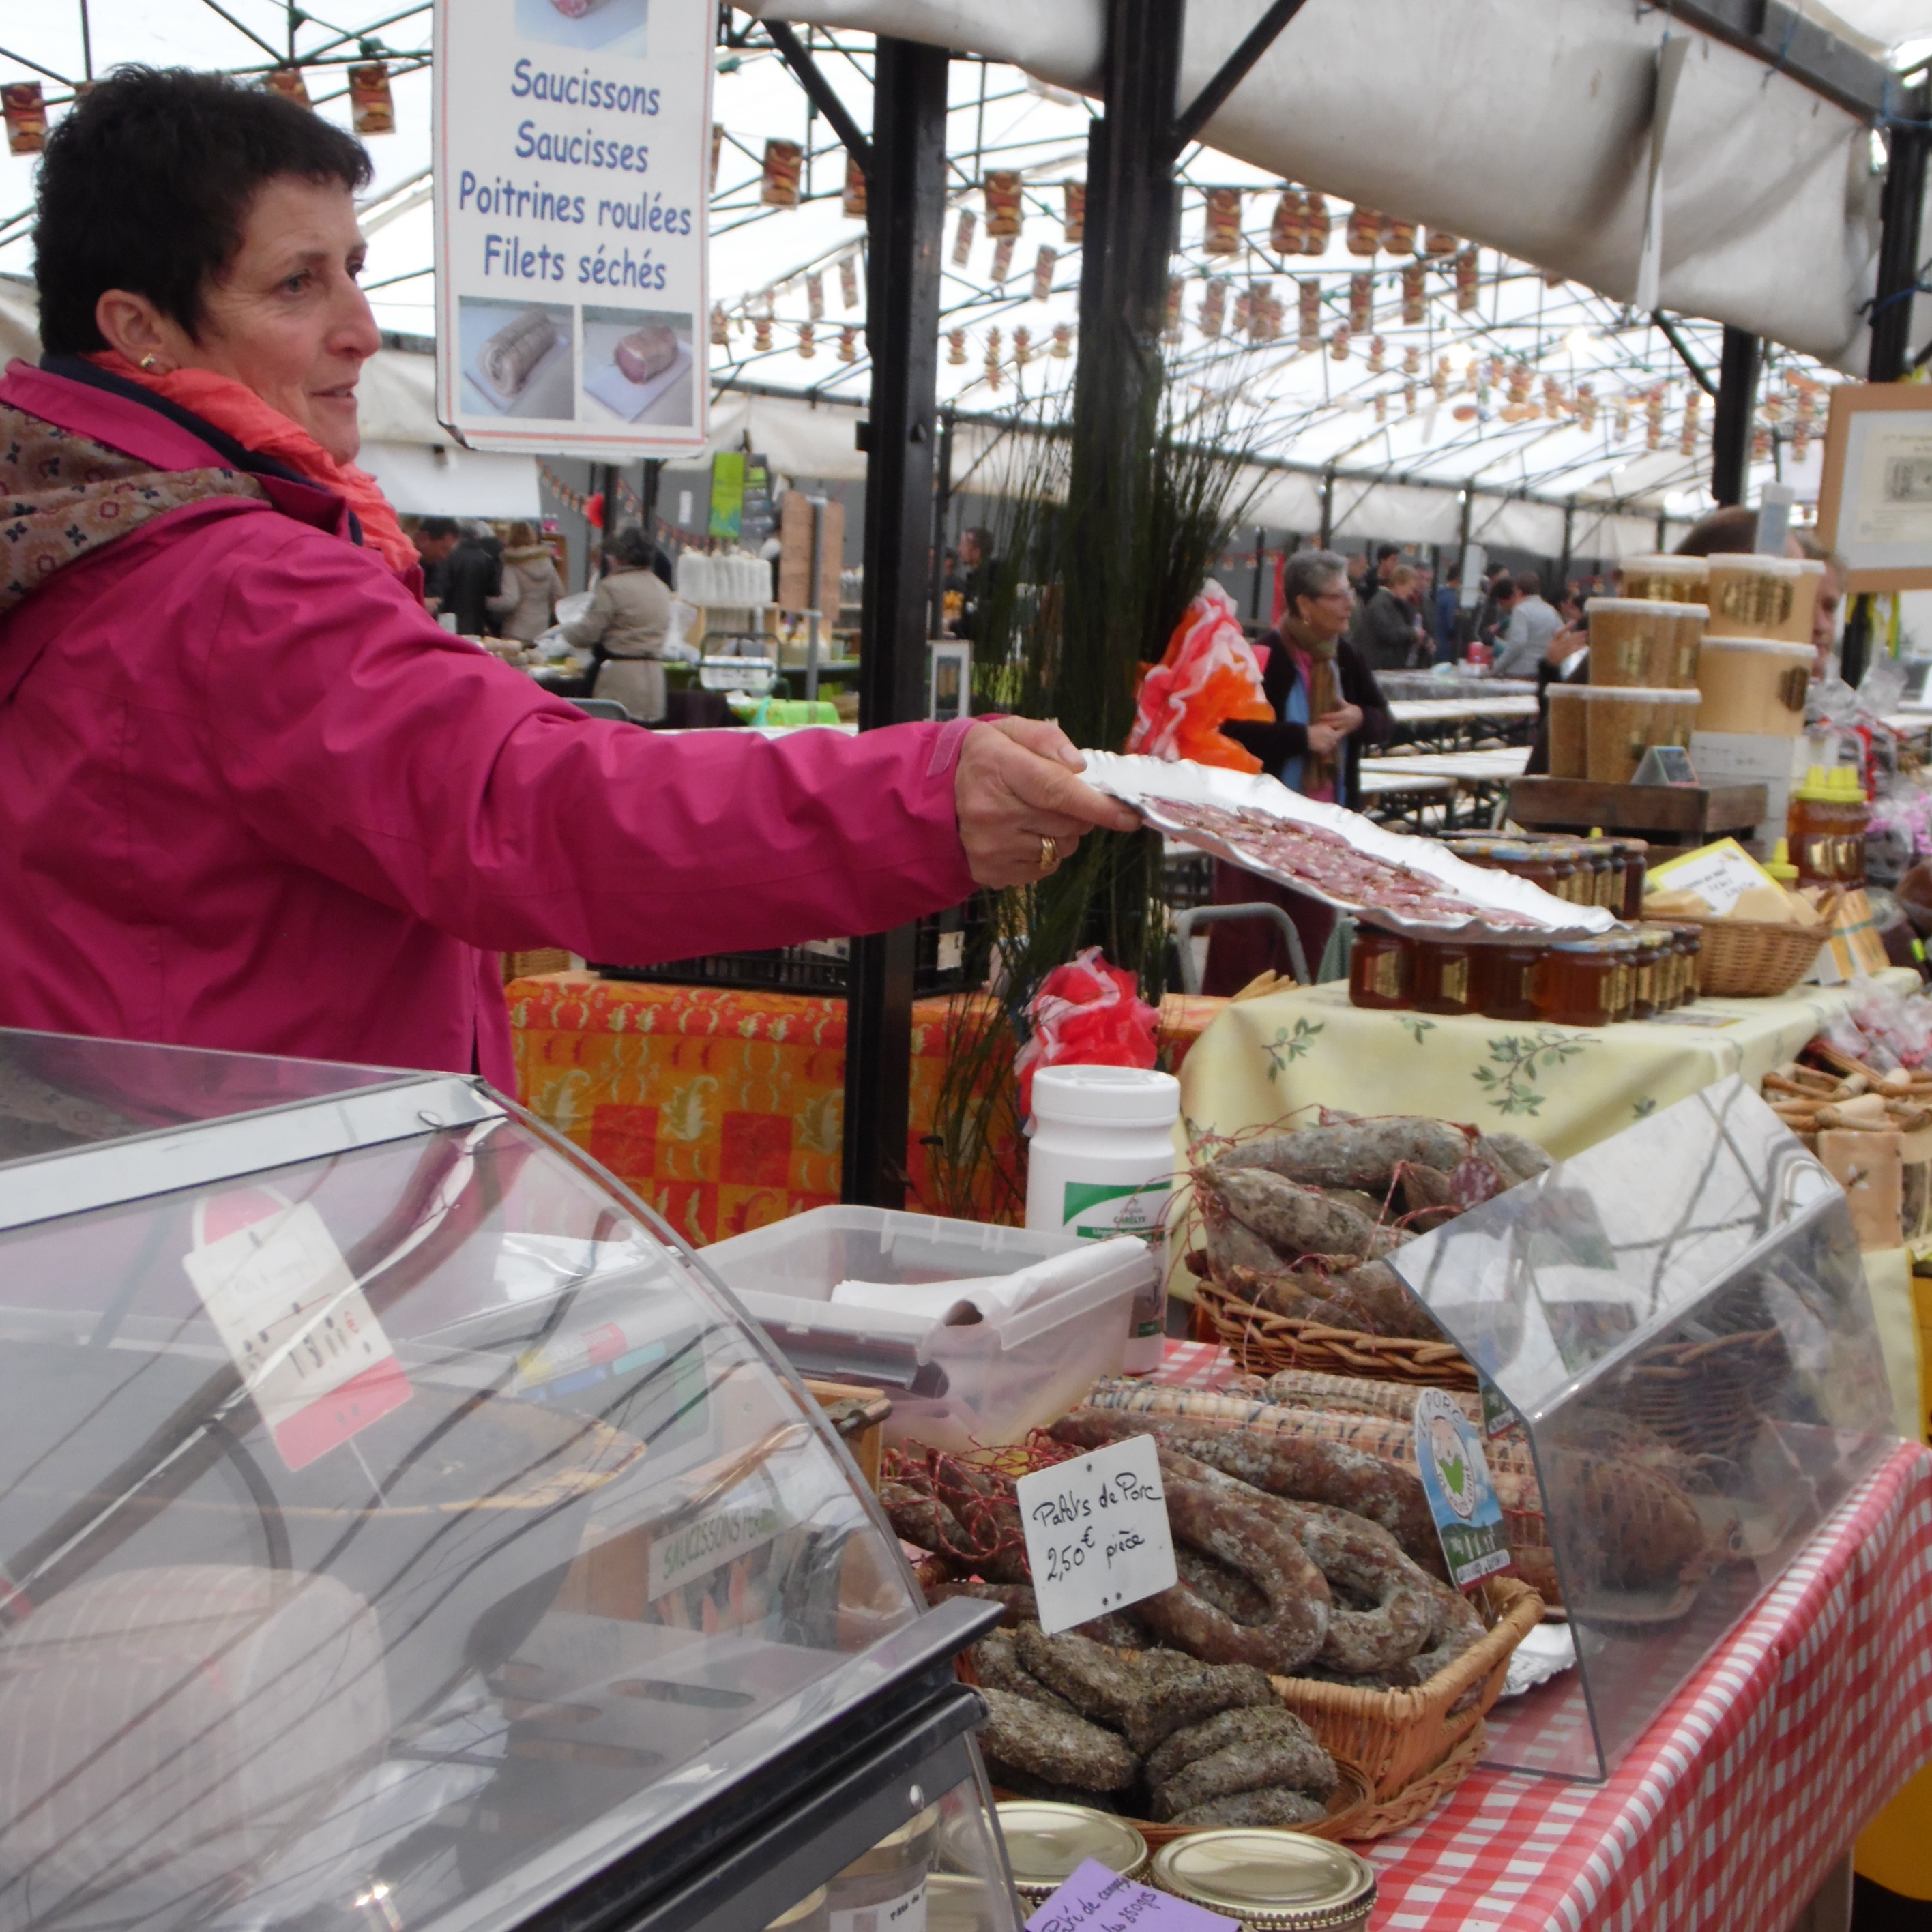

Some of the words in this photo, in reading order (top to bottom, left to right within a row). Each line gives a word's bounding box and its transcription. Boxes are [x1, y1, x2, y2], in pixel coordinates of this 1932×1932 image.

[511, 58, 660, 116] Saucissons
[515, 120, 649, 173] Saucisses
[460, 171, 585, 224] Poitrines
[598, 191, 691, 235] roulées
[484, 234, 565, 281] Filets
[578, 244, 666, 290] séchés
[1424, 1390, 1461, 1423] PORC
[1099, 1482, 1118, 1509] de
[1115, 1472, 1162, 1502] Porc
[1077, 1897, 1100, 1915] de
